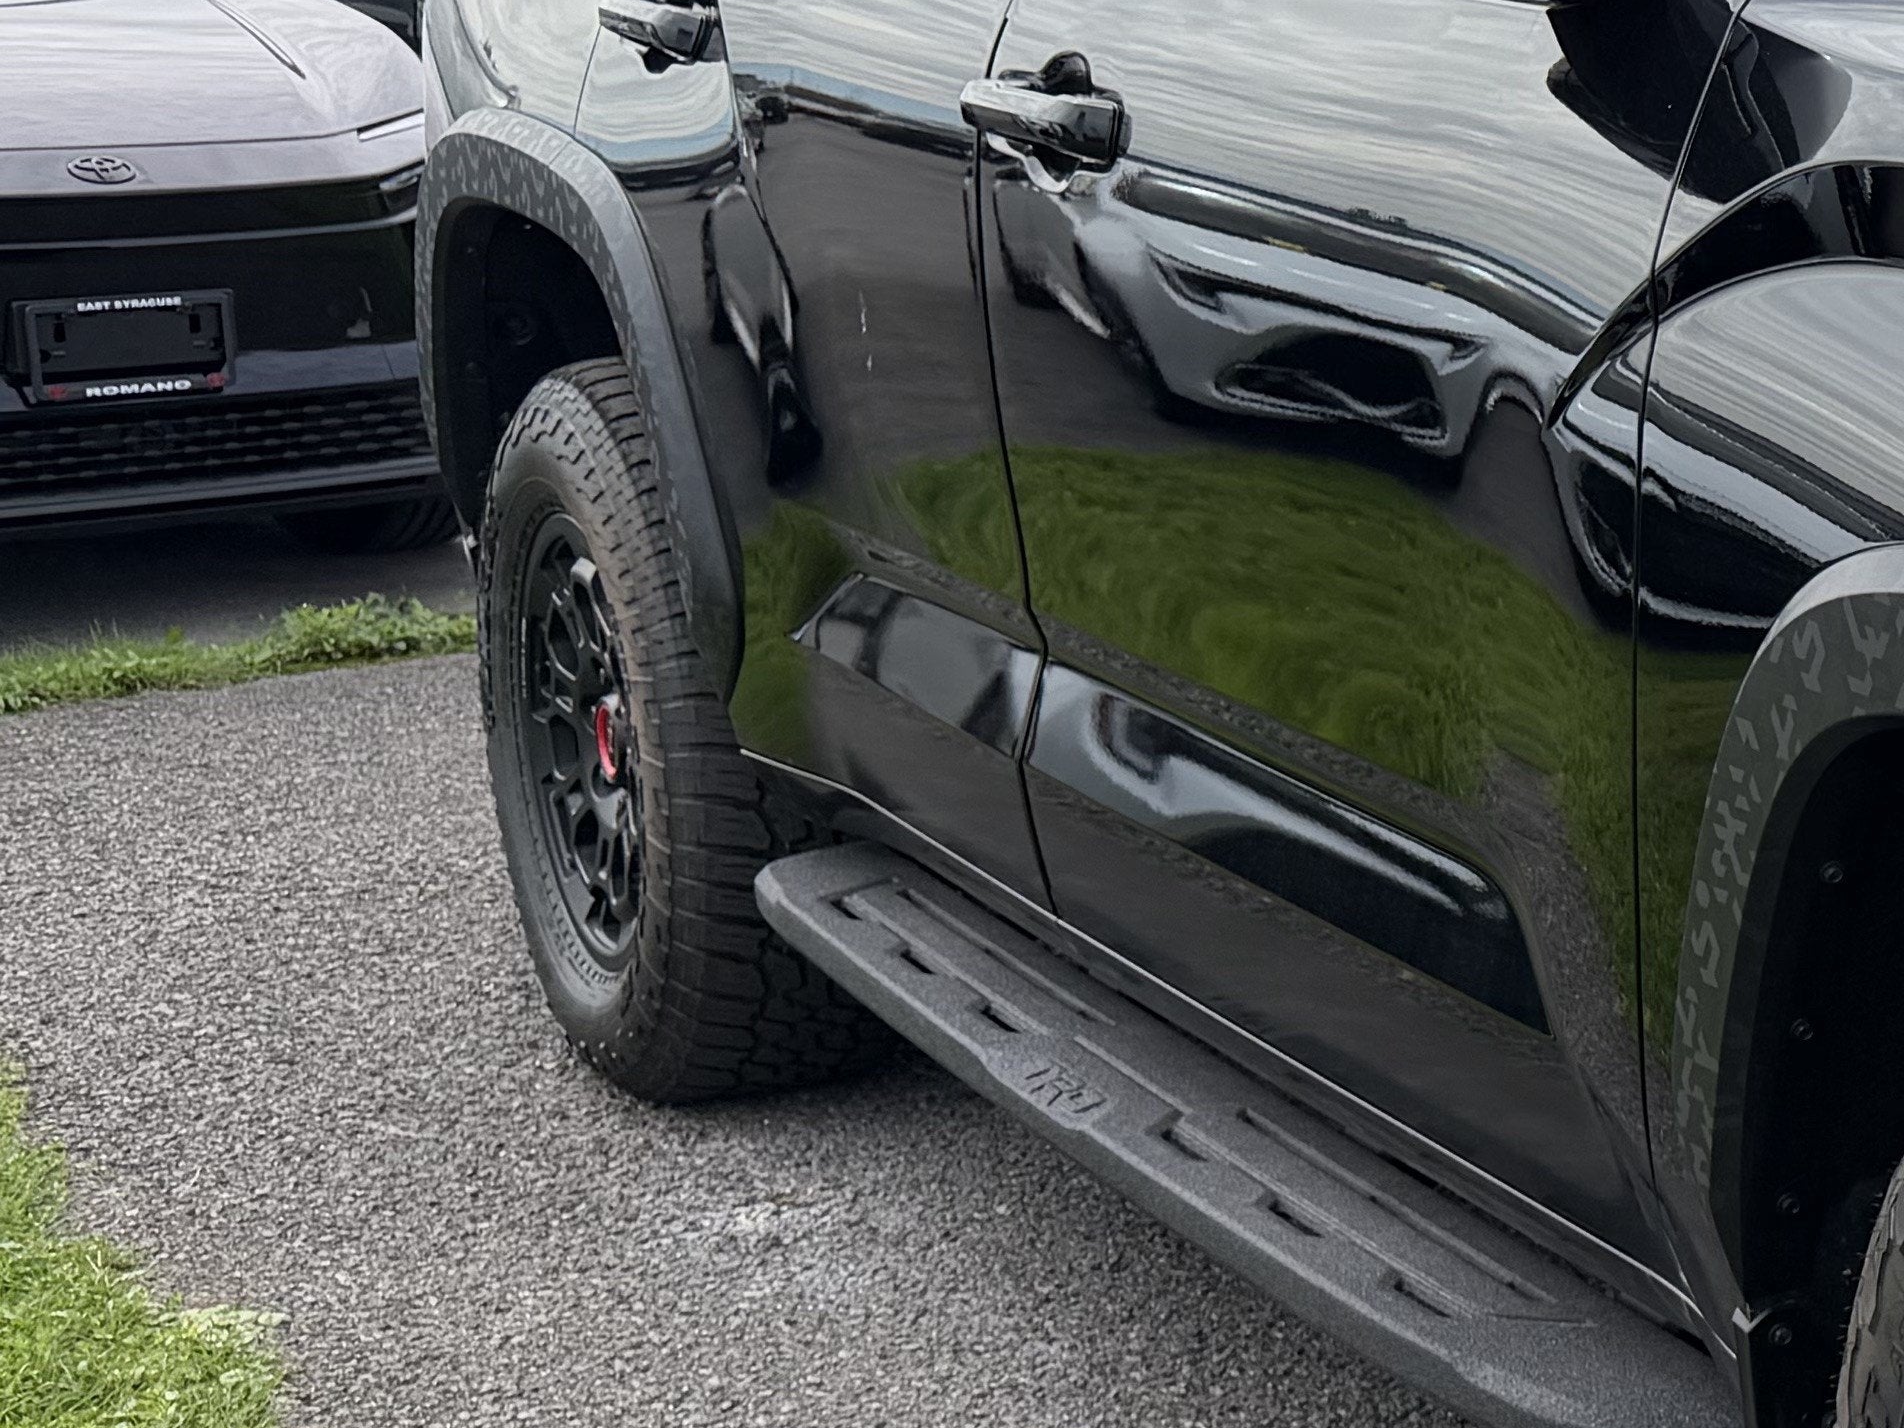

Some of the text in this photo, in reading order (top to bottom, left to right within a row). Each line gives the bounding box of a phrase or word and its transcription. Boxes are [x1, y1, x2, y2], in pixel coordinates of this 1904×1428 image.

[76, 296, 182, 313] EAST SYRACUSE
[84, 378, 193, 398] ROMANO
